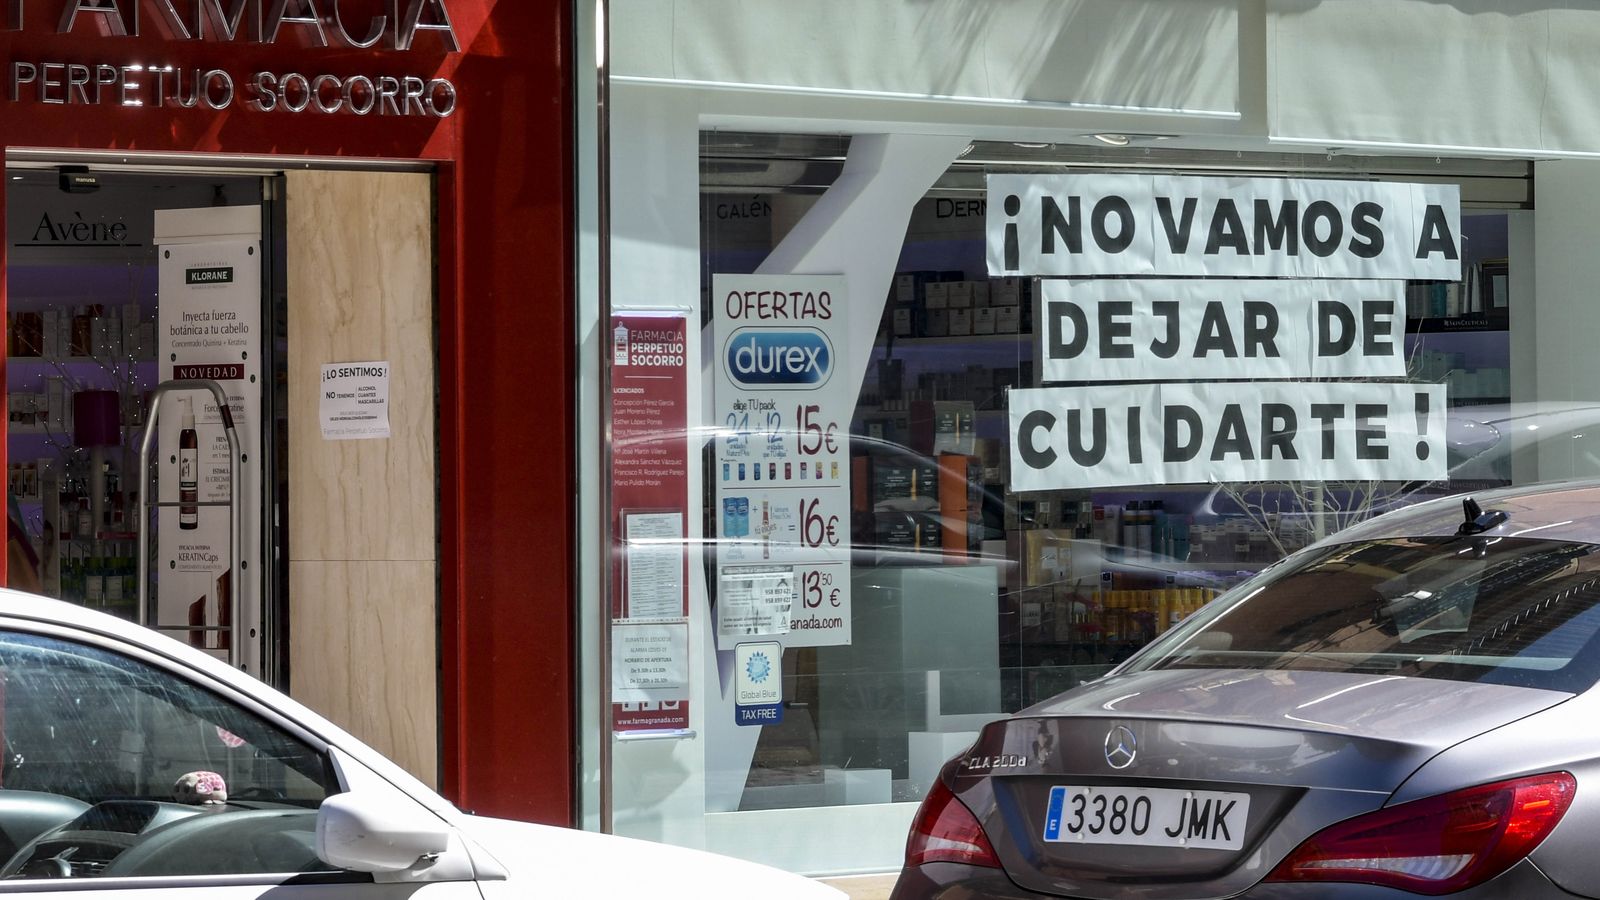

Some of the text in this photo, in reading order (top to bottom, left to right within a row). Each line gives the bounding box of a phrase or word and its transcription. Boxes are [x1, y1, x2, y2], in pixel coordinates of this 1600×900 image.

[14, 61, 457, 118] PERPETUO SOCORRO
[32, 211, 128, 242] Avène
[1155, 196, 1385, 259] VAMOS
[1415, 204, 1459, 260] A
[191, 271, 228, 281] KLORANE
[725, 290, 832, 320] OFERTAS
[182, 309, 236, 325] Inyecta fuerza
[170, 324, 203, 336] botánica
[210, 325, 219, 335] tu
[220, 322, 249, 334] cabello
[631, 330, 684, 342] FARMACIA
[1047, 300, 1395, 360] DEJAR DE
[631, 342, 684, 354] PERPETUO
[631, 354, 684, 367] SOCORRO
[735, 336, 823, 375] durex
[180, 366, 238, 379] NOVEDAD
[325, 391, 336, 399] NO
[733, 398, 777, 414] elige TU pack
[741, 689, 777, 699] Global Blue
[617, 716, 684, 726] www.farmagranada.com
[741, 708, 777, 720] TAX FREE
[968, 755, 991, 770] CLA
[1049, 793, 1237, 841] E 3380 JMK
